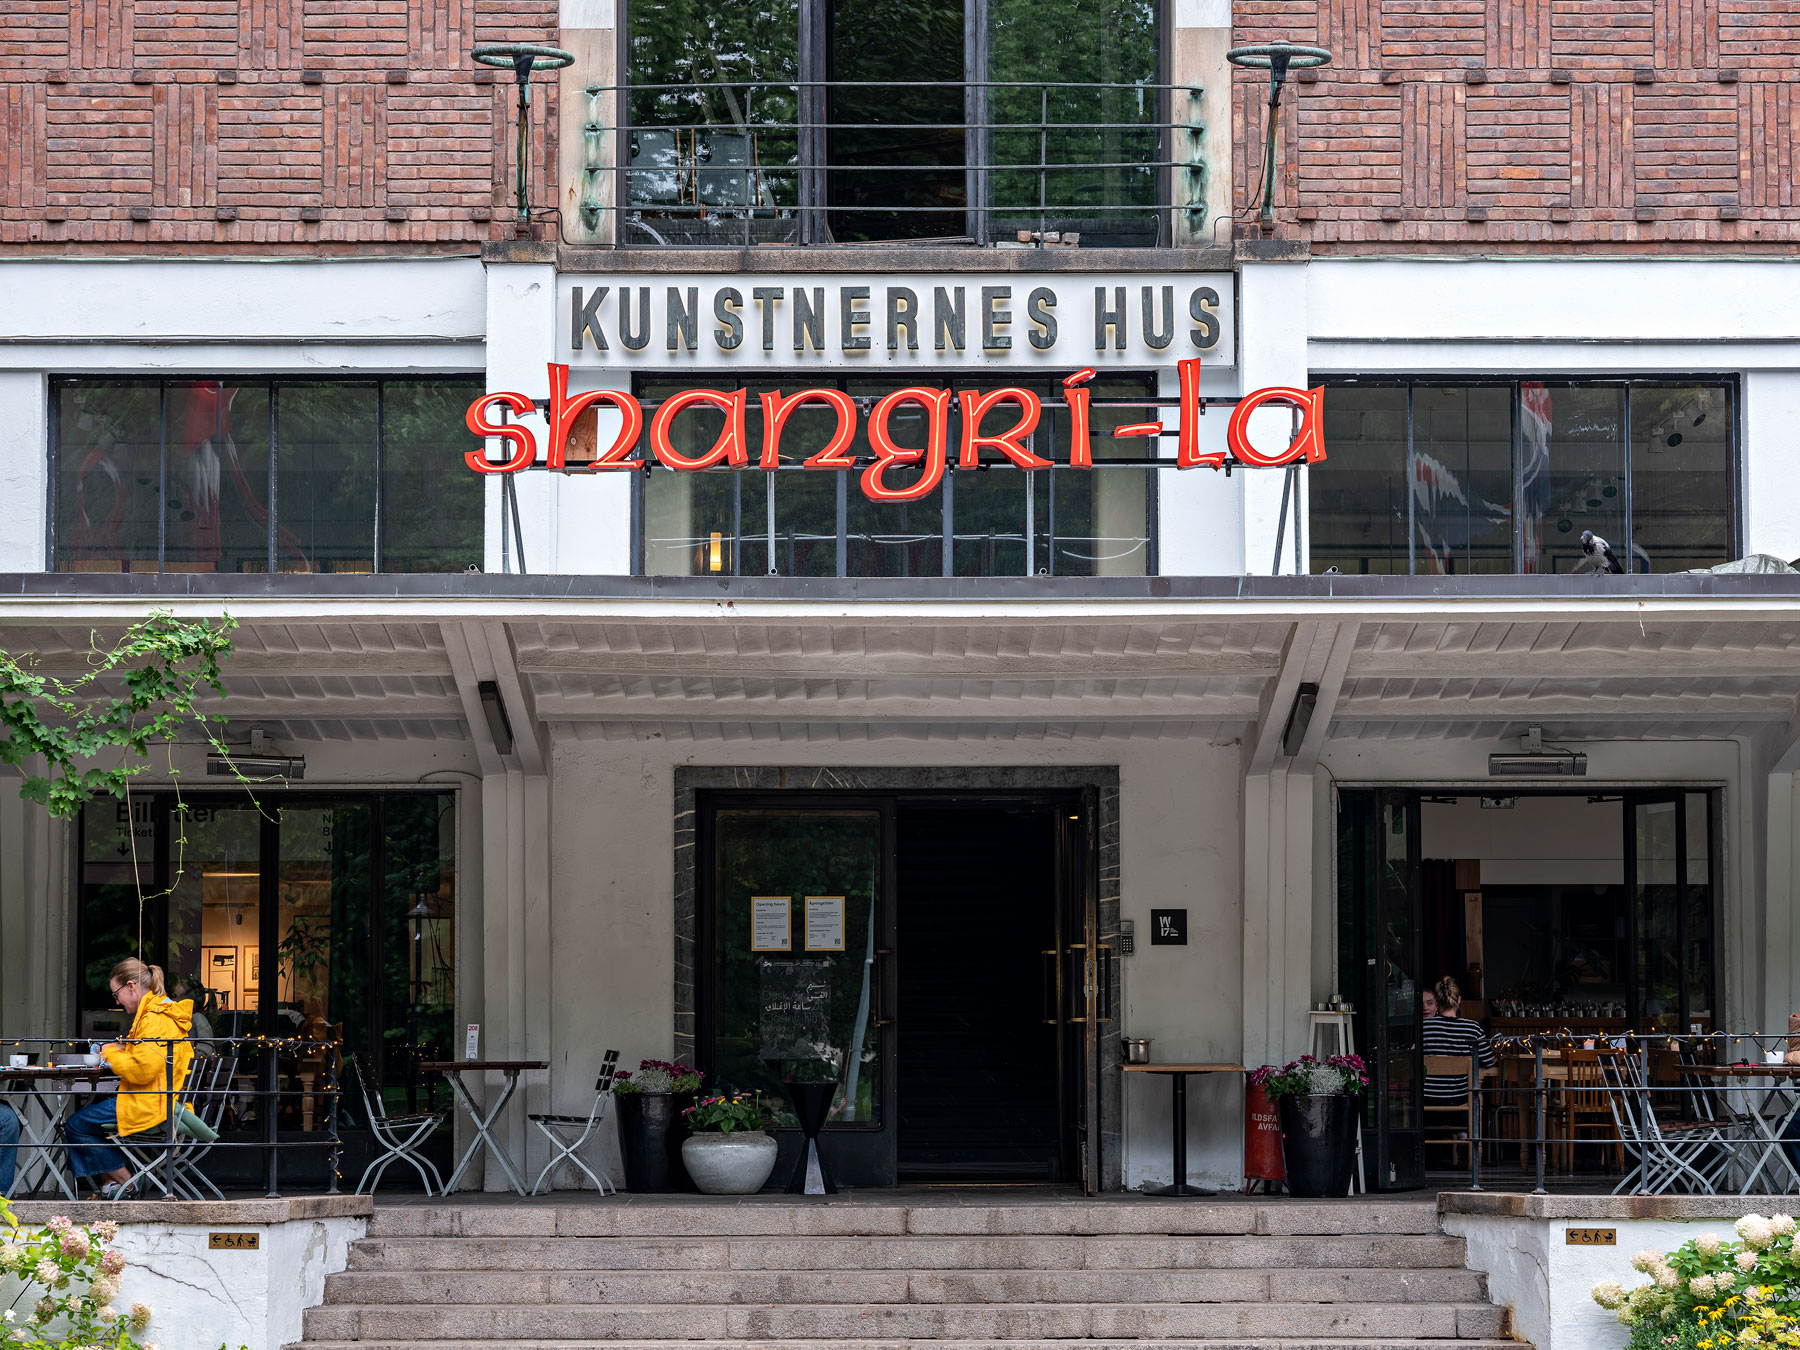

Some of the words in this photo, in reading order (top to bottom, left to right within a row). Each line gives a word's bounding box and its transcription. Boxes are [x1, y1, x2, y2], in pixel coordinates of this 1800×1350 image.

[571, 286, 1058, 350] KUNSTNERNES
[1094, 285, 1221, 350] HUS
[116, 801, 217, 823] Billtter
[116, 827, 153, 837] Ticket
[1251, 1112, 1280, 1123] ILDSFA
